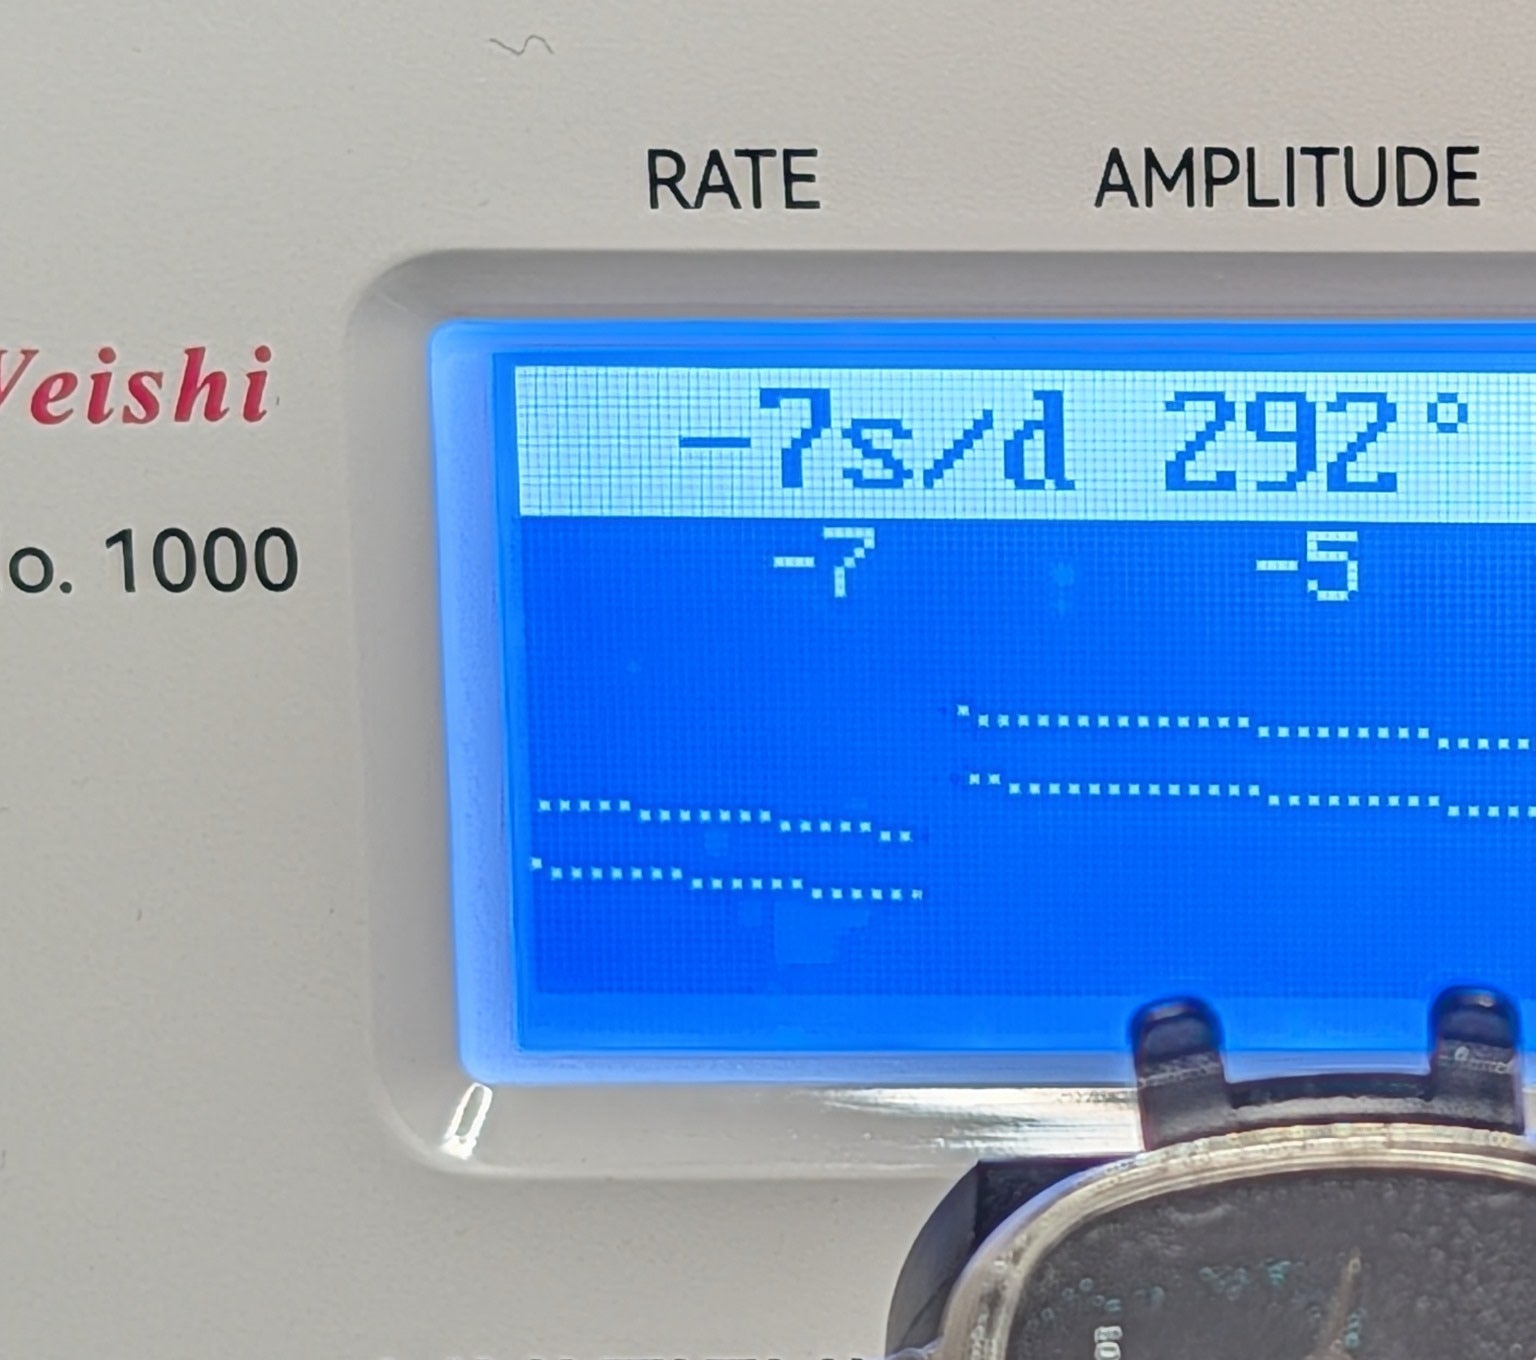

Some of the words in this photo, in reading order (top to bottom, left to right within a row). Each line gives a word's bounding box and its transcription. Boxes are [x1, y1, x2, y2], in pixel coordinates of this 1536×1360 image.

[647, 148, 821, 210] RATE
[1094, 145, 1481, 208] AMPLITUDE
[1164, 390, 1468, 493] 292°
[105, 526, 298, 594] 1000
[774, 527, 875, 597] -7
[1256, 531, 1358, 601] -5
